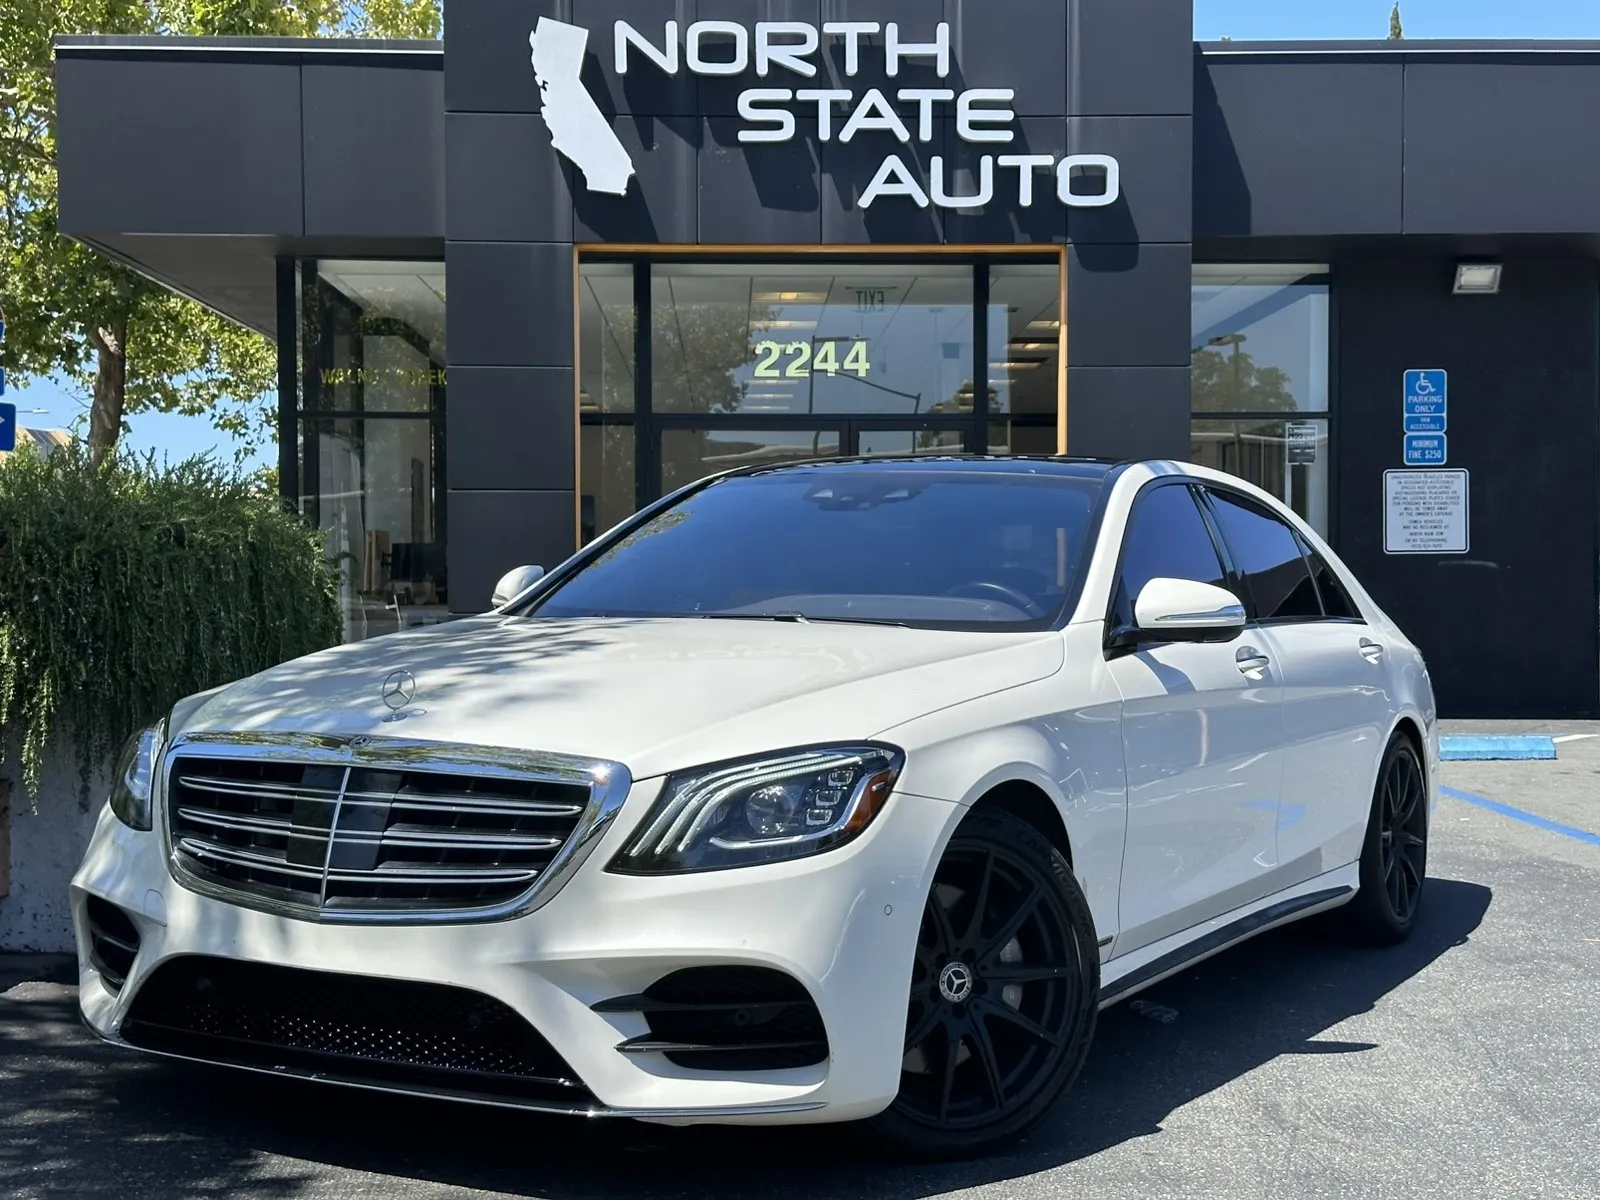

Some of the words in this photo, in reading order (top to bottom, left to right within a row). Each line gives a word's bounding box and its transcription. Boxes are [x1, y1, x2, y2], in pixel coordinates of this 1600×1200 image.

[614, 20, 949, 77] NORTH
[737, 88, 1015, 142] STATE
[858, 153, 1120, 209] AUTO
[754, 340, 871, 377] 2244
[1408, 395, 1443, 403] PARKING
[1414, 405, 1436, 413] ONLY
[1408, 449, 1423, 459] FINE
[1425, 449, 1442, 459] $250
